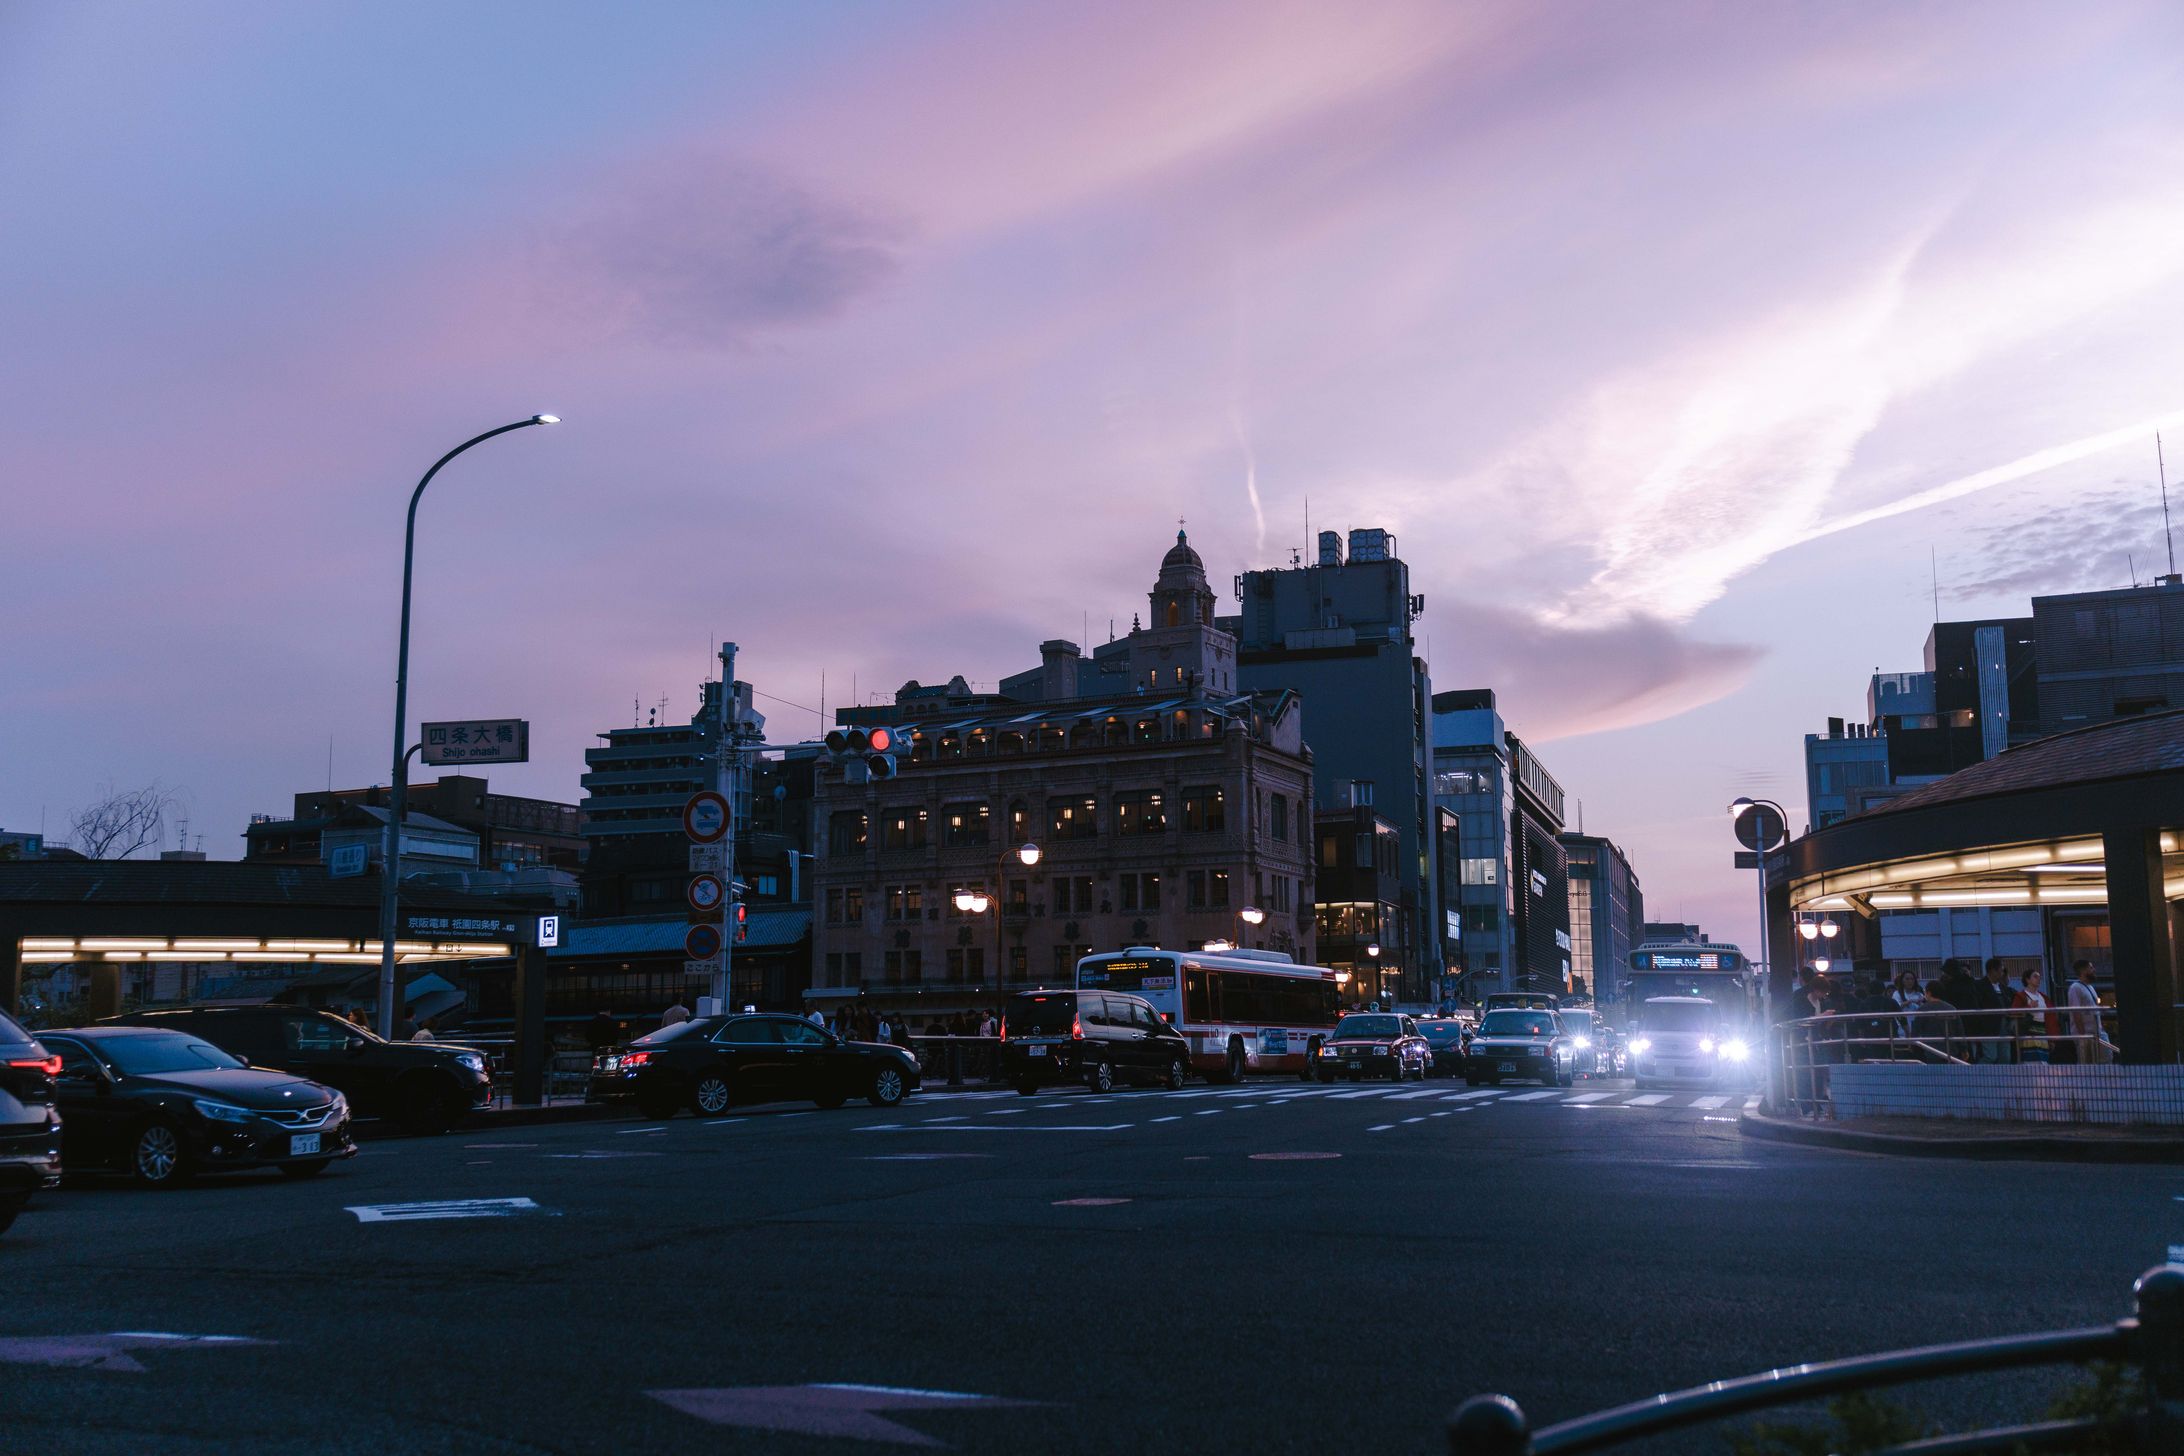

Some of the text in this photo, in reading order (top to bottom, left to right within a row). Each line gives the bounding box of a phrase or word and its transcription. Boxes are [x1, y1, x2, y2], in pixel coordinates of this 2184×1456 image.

[429, 724, 513, 746] 四条大橋
[442, 745, 500, 758] Shijo ohashi
[407, 917, 449, 929] 京阪電車
[451, 918, 501, 931] 祇園四条駅
[686, 963, 720, 972] ここから
